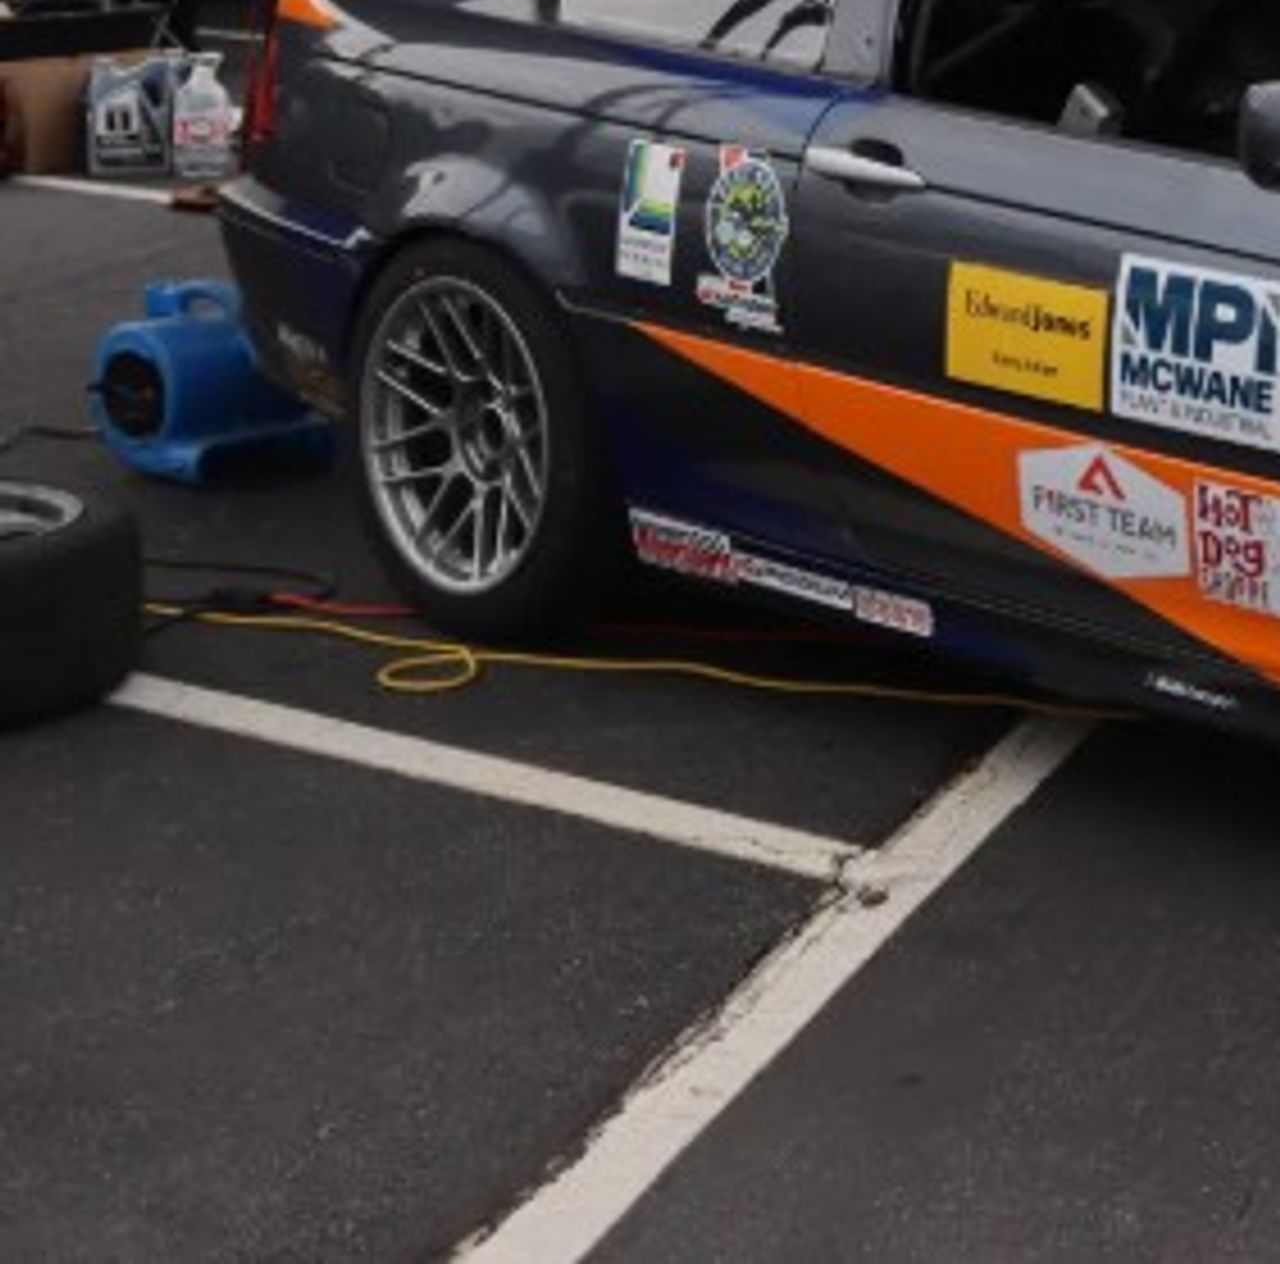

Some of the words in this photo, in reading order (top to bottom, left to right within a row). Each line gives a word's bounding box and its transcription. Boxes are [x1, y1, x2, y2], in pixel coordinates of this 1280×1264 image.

[1119, 350, 1275, 415] MCWANE
[1032, 484, 1101, 527] FIRST
[1107, 506, 1177, 550] TEAM
